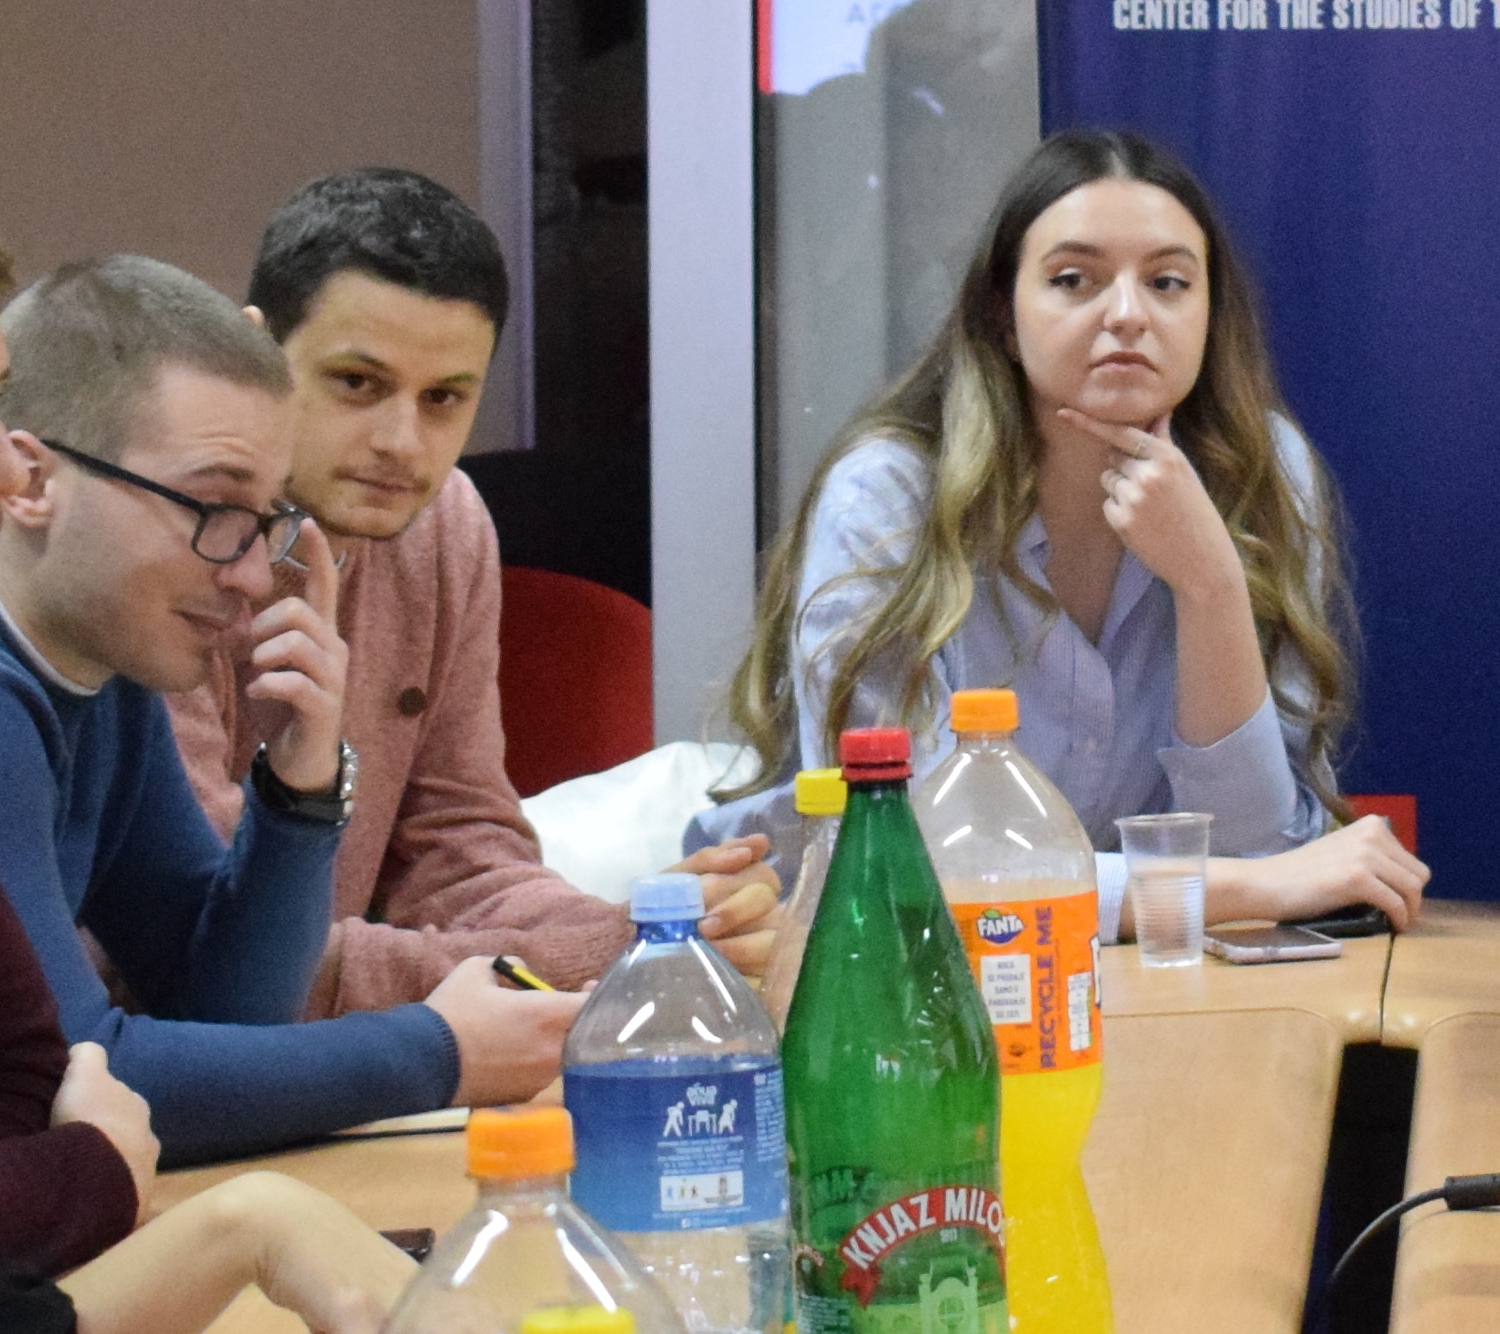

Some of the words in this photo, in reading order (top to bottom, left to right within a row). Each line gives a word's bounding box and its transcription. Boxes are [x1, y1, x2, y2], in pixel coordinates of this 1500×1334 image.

[977, 914, 1025, 937] FANTA
[1035, 907, 1053, 945] ME
[1036, 956, 1057, 1068] RECYCLE
[843, 1193, 936, 1270] KNJAZ
